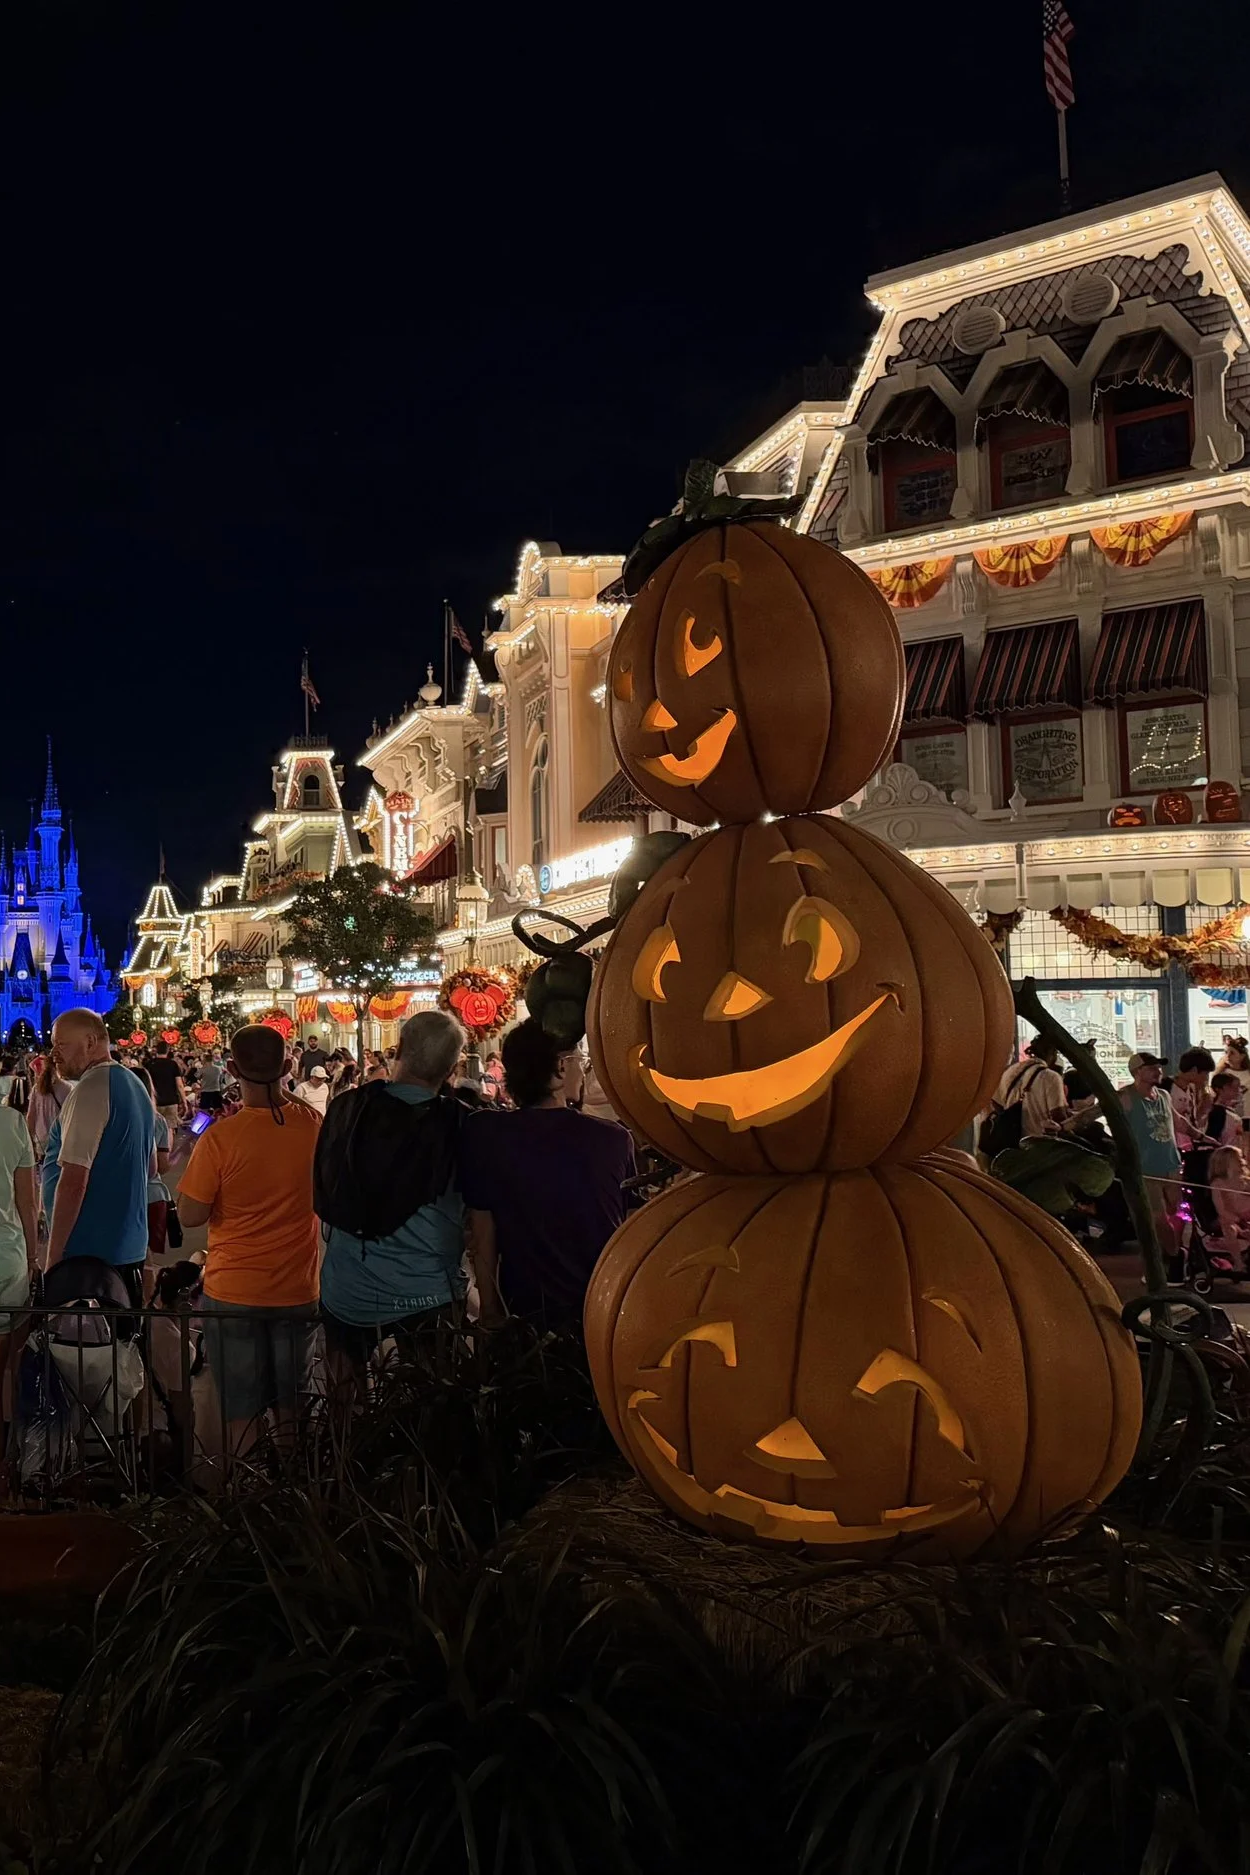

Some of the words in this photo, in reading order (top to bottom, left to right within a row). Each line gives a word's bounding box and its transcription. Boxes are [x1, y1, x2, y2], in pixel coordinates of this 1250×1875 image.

[1015, 729, 1076, 747] DRAUGHTING
[1014, 758, 1079, 779] CORPORATION
[386, 797, 412, 807] MAIN
